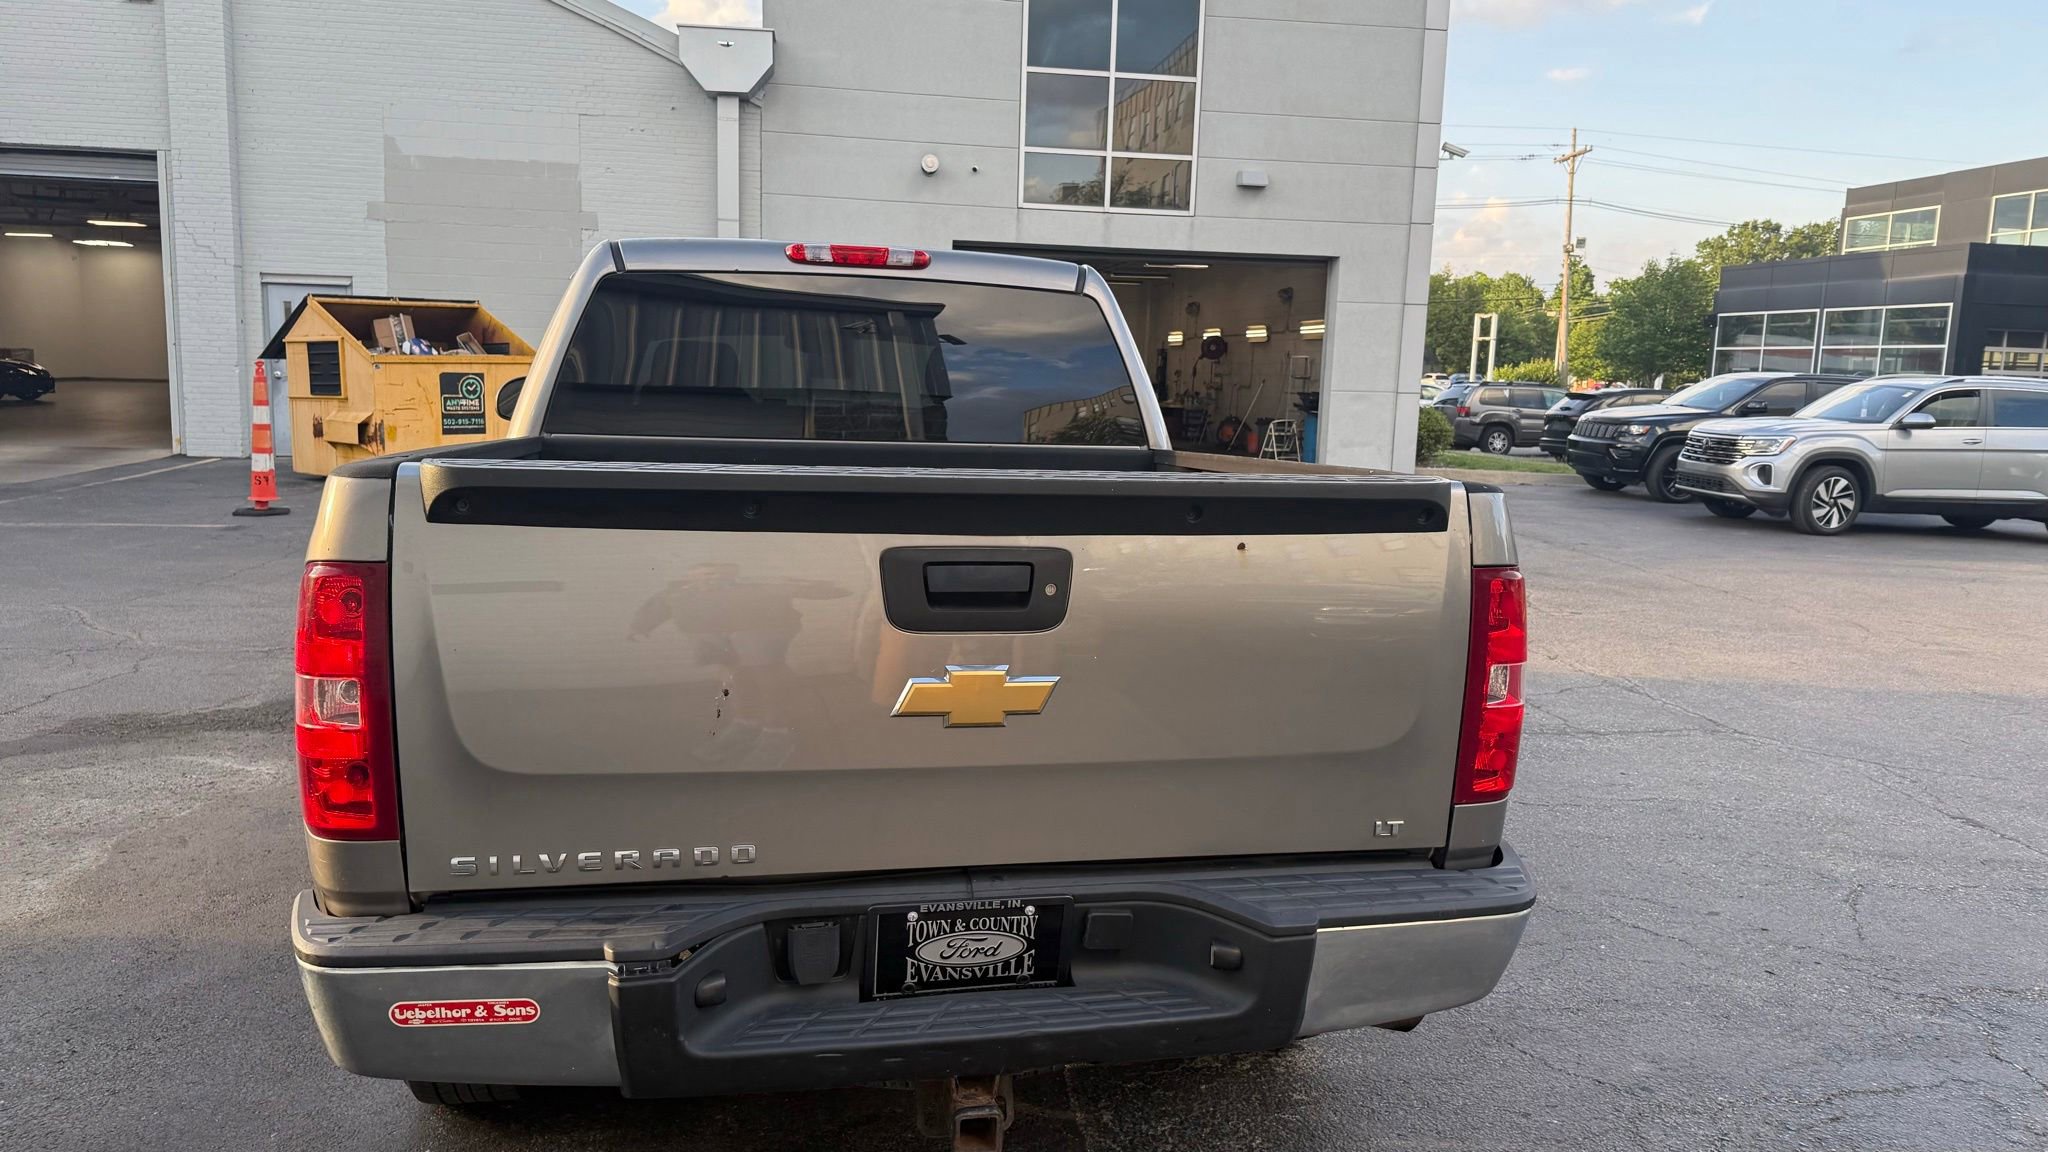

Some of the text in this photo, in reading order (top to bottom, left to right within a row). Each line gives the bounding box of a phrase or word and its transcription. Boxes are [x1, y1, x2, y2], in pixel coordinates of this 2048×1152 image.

[1374, 820, 1405, 837] LT
[450, 844, 756, 876] SILVERADO
[920, 899, 1025, 913] EVANSVILLE, IN.
[906, 914, 1039, 948] TOWN & COUNTRY
[940, 936, 1003, 960] Ford
[904, 949, 1036, 984] EVANSVILLE
[394, 1004, 536, 1020] Uebelhor & Sons
